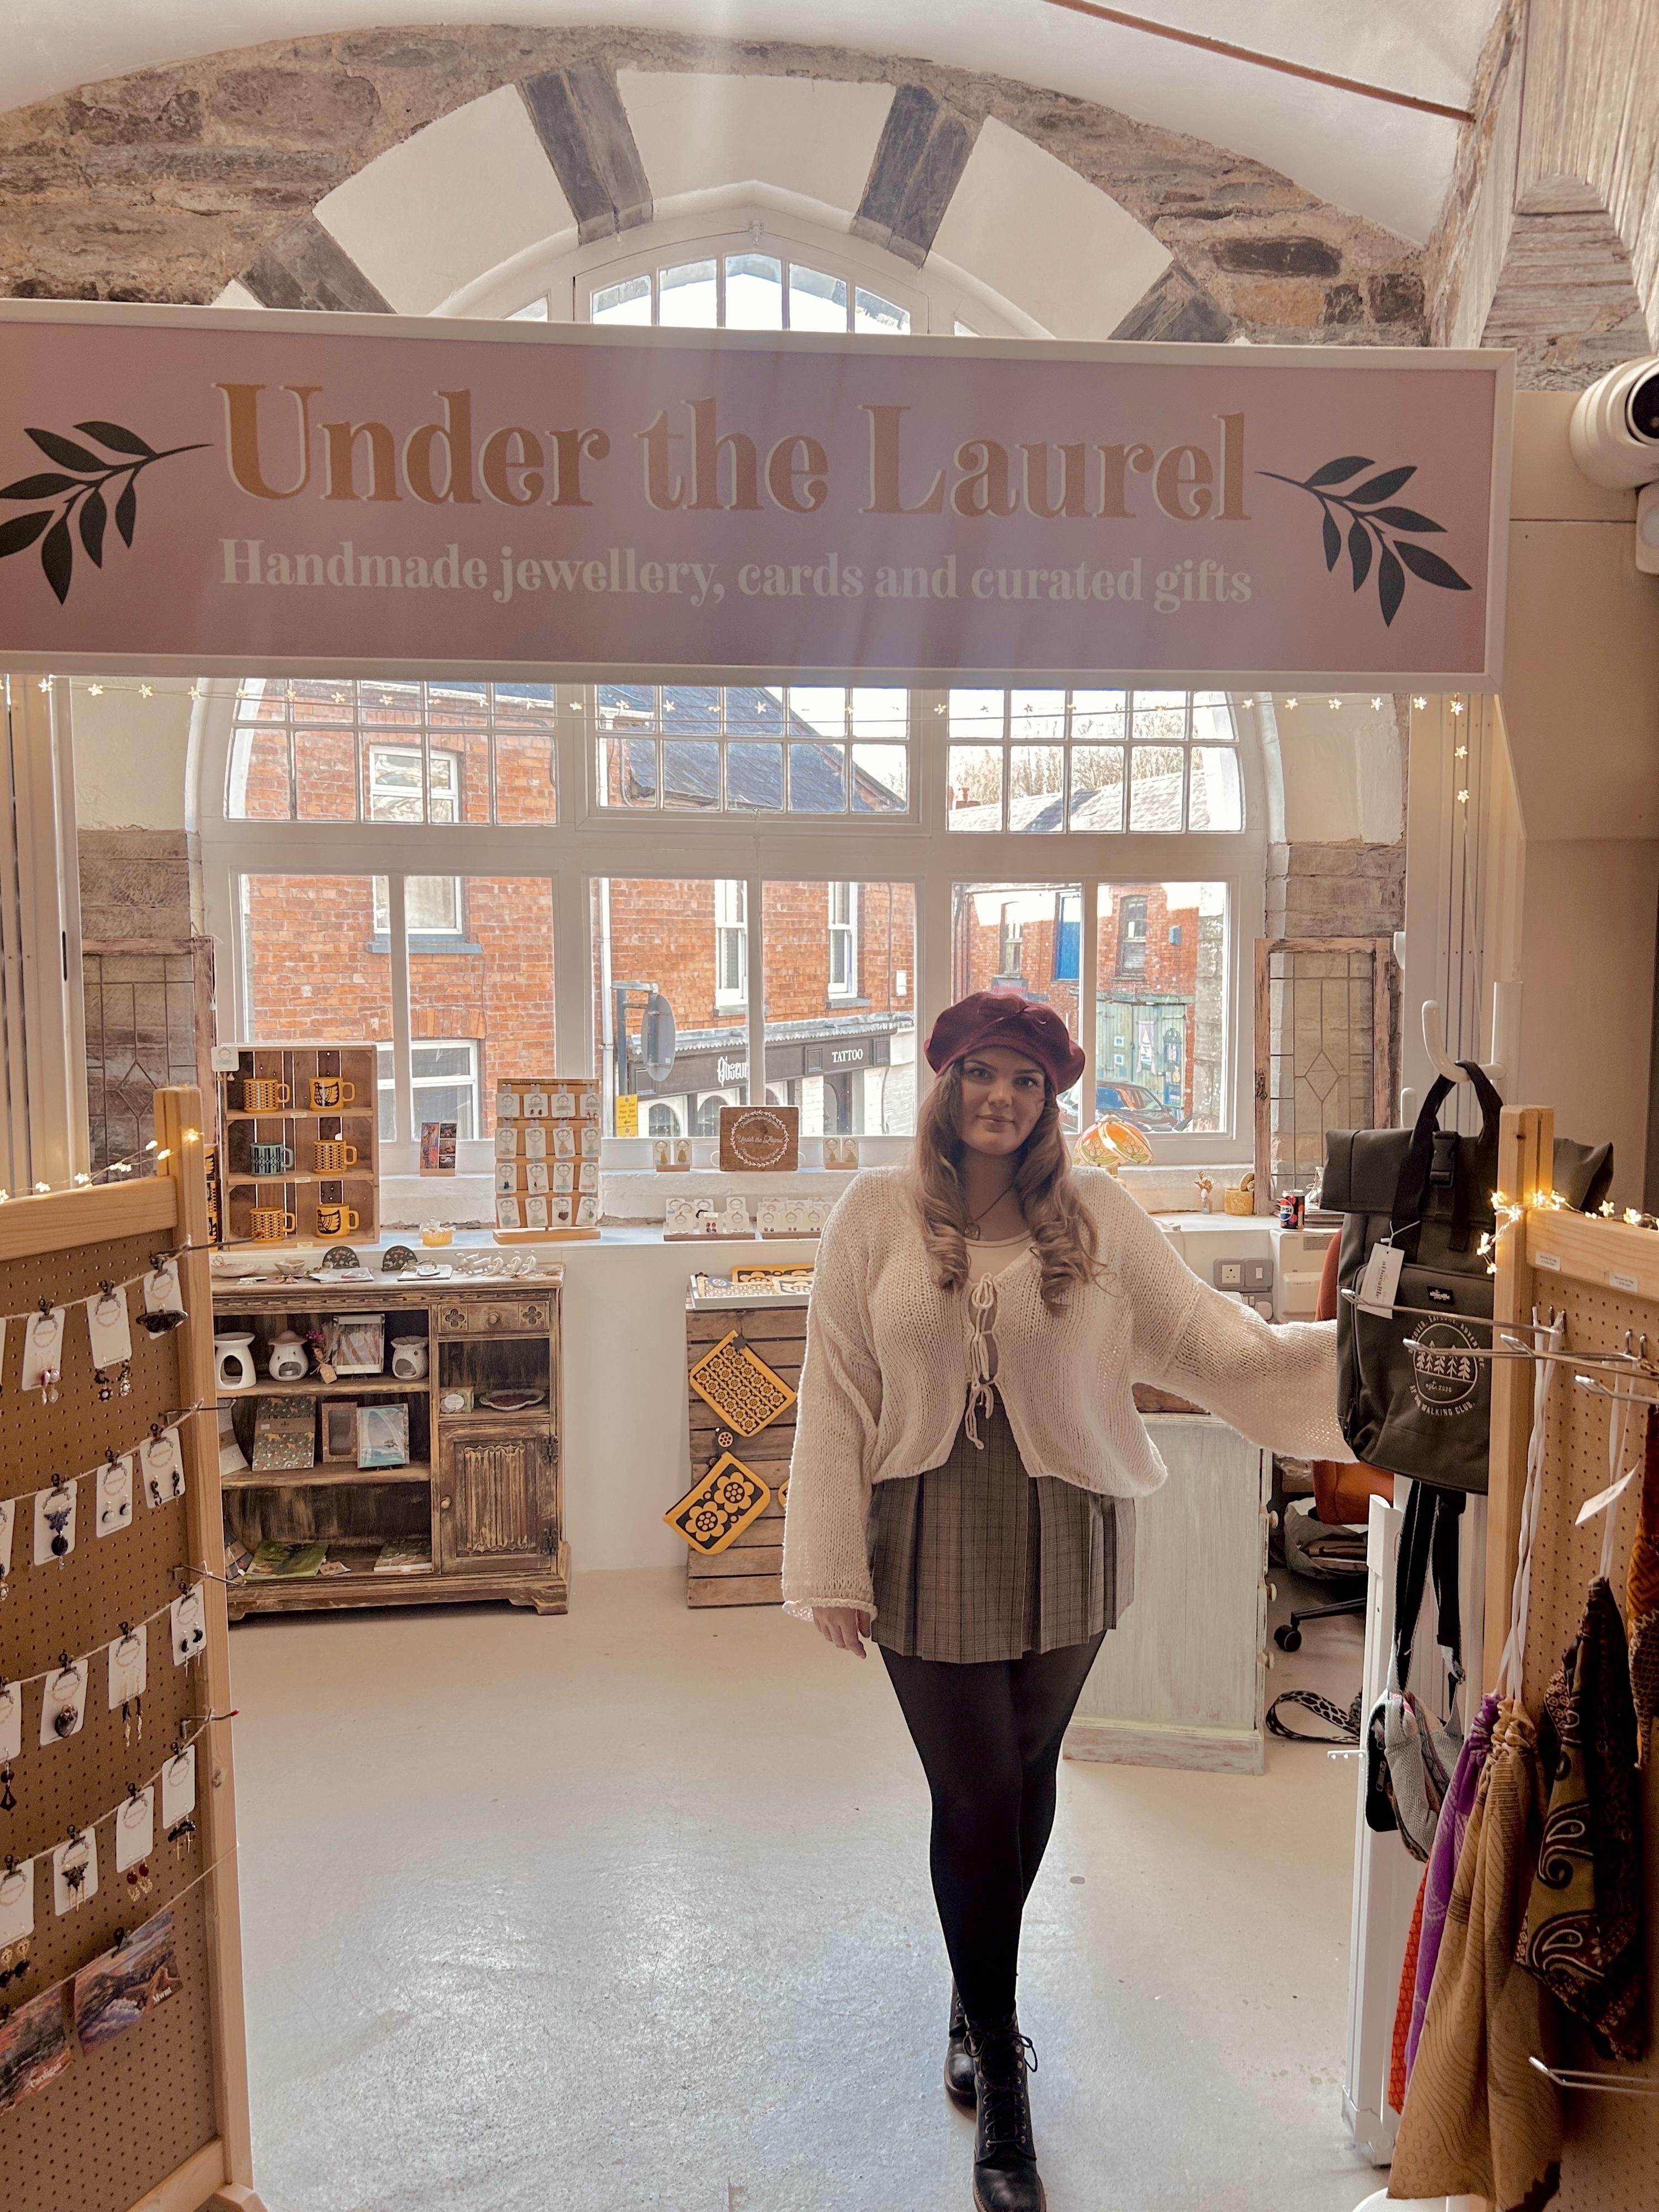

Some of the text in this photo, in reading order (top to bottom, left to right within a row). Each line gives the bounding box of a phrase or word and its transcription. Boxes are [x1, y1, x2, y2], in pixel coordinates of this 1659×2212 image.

[212, 383, 1252, 521] Under the Laurel
[218, 538, 1252, 614] Handmade jewellery, cards and curated gifts
[832, 1048, 863, 1063] TATTOO
[1408, 1321, 1428, 1354] DCOVER.
[1421, 1403, 1453, 1416] WALKING
[152, 1986, 172, 2002] Mwnt
[30, 2062, 62, 2088] Cardigan
